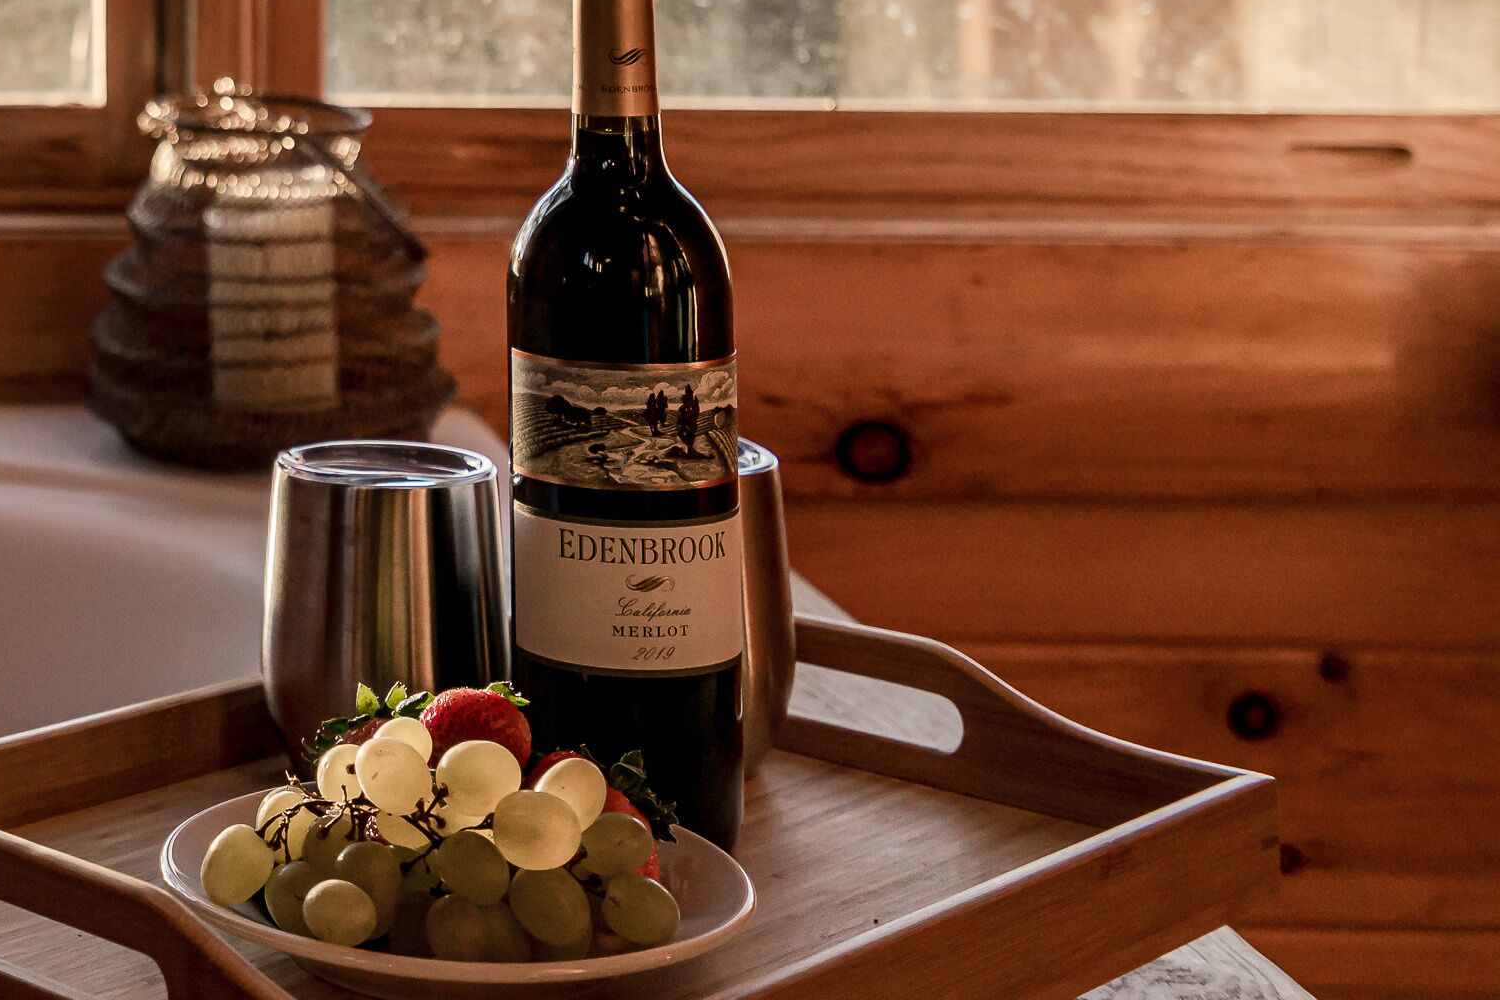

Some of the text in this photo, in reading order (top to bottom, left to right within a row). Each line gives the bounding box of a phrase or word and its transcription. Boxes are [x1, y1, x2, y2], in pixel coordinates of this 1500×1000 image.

[601, 84, 656, 93] EDENBRO
[558, 528, 726, 565] EDENBROOK
[615, 597, 692, 622] California
[612, 624, 689, 637] MERLOT
[632, 646, 676, 661] 2019
